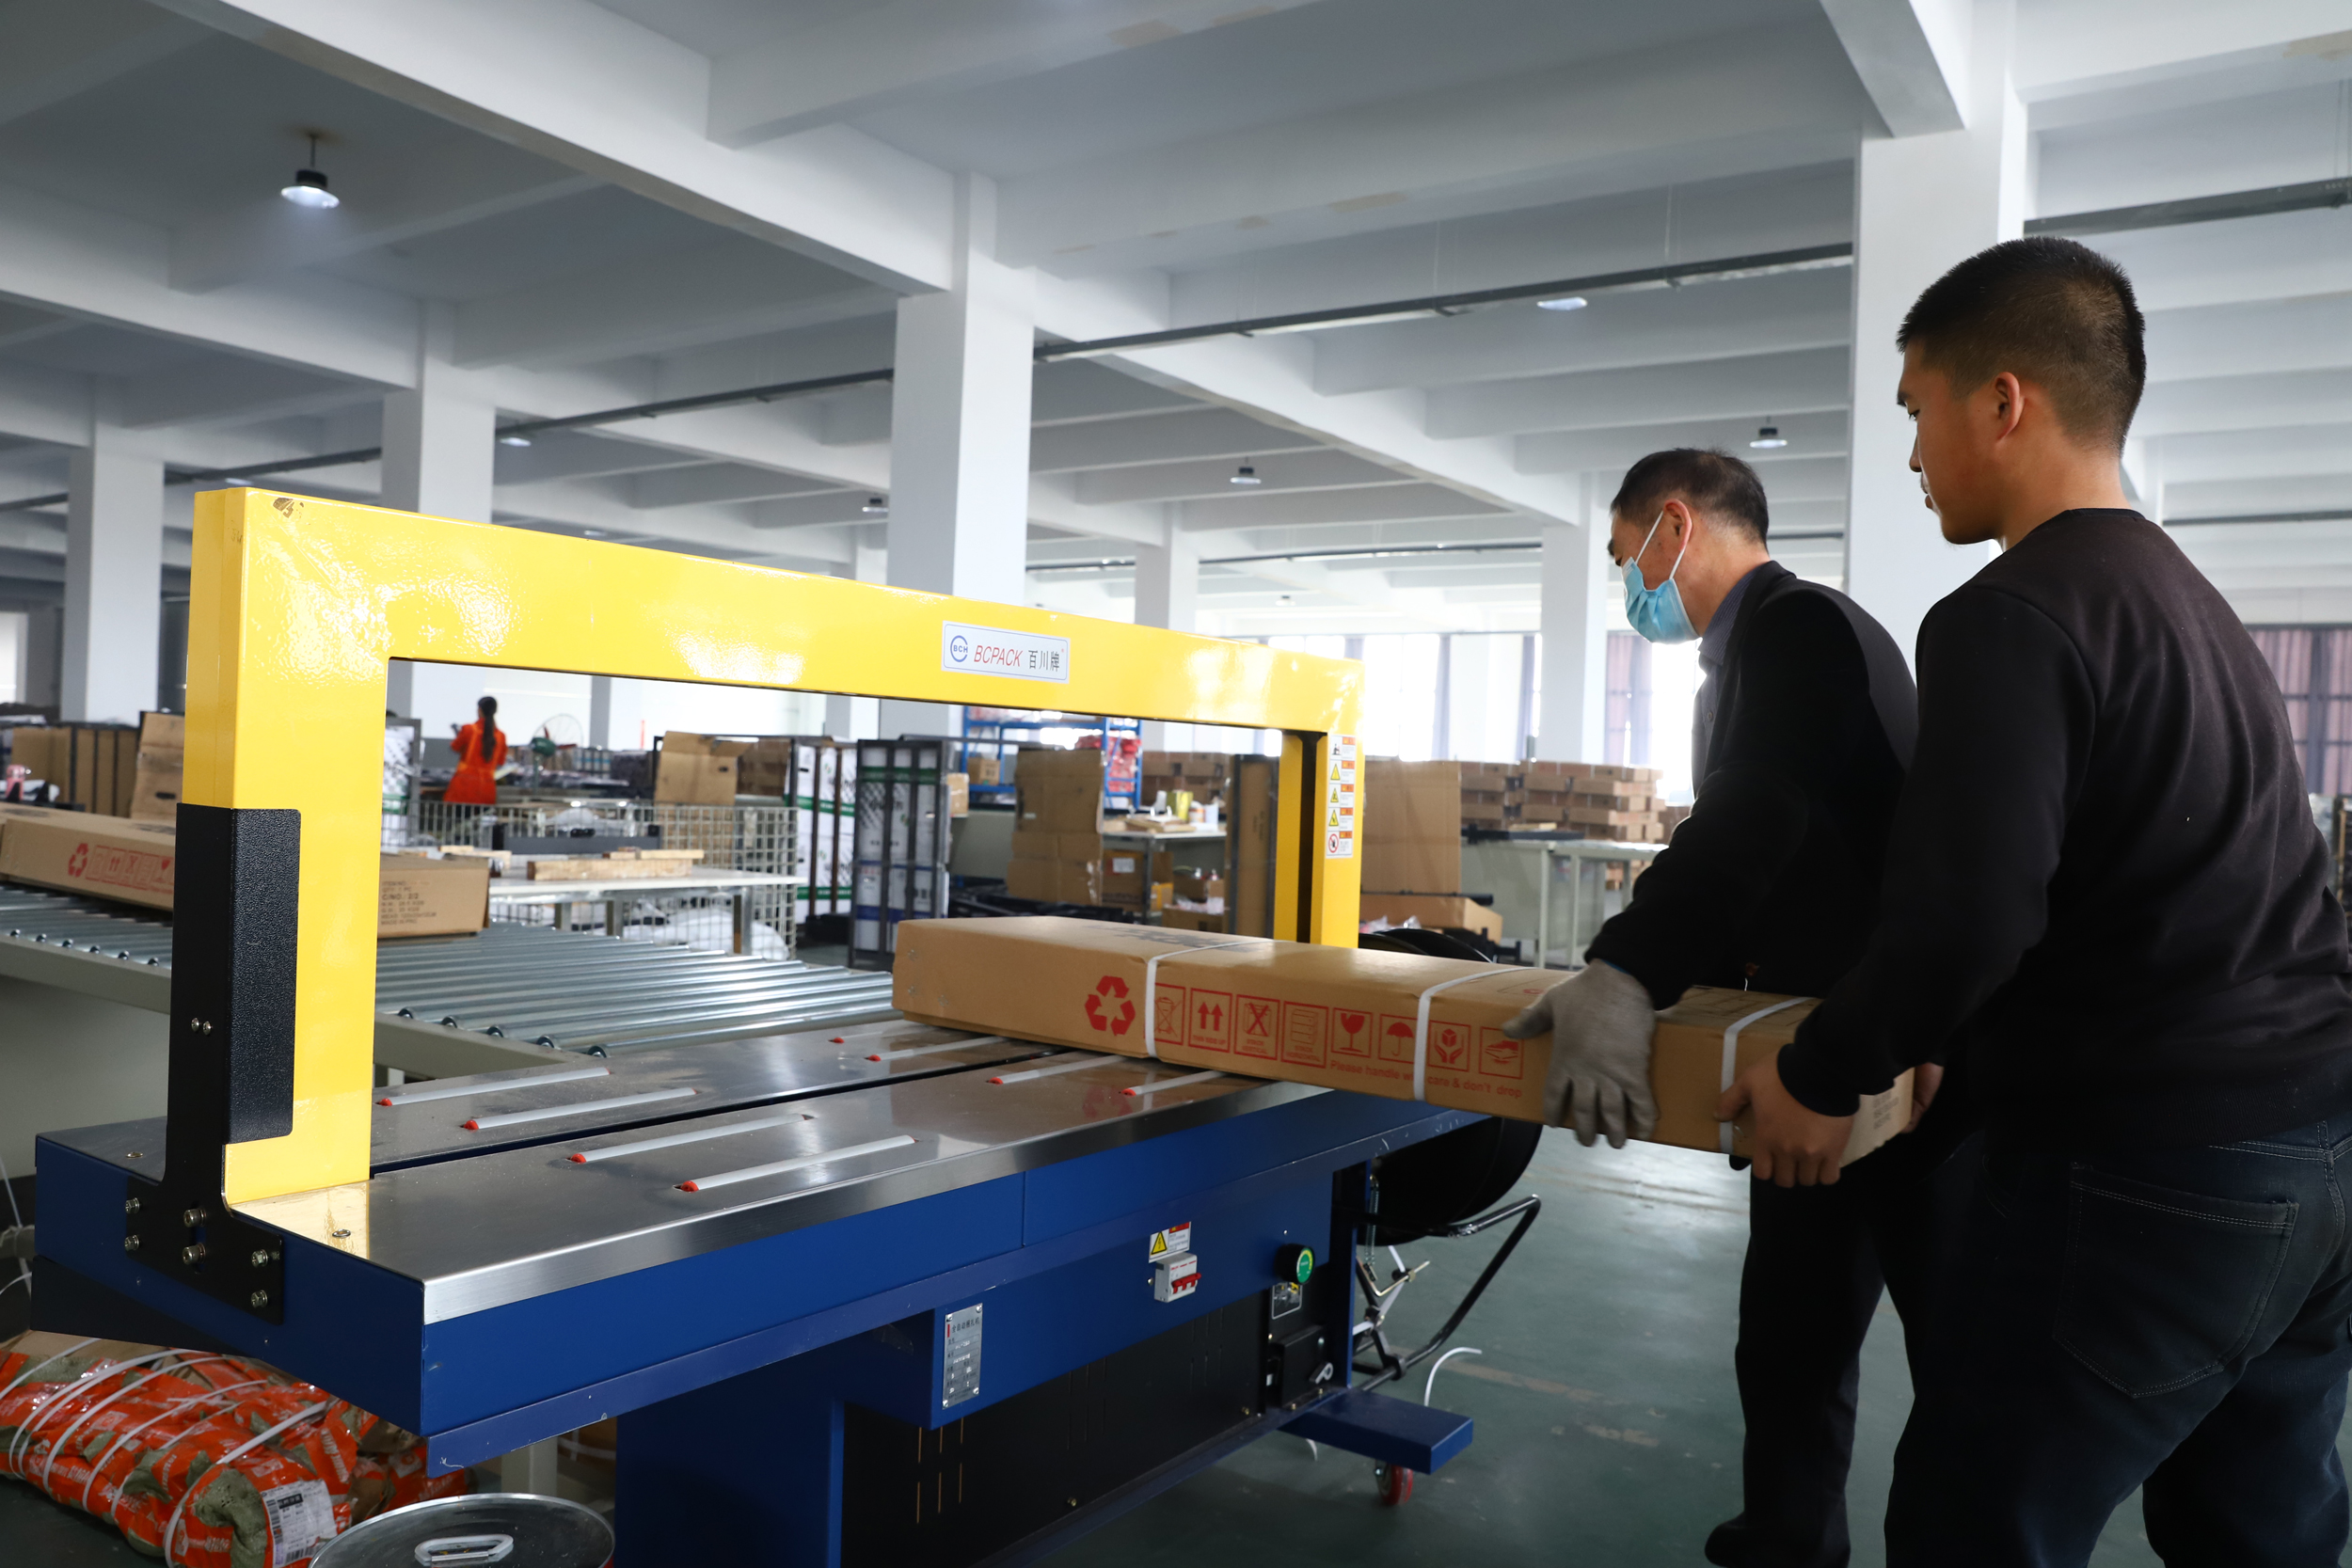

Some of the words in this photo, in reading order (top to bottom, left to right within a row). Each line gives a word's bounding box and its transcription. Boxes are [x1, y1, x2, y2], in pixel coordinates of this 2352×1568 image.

[953, 644, 968, 654] BCH
[974, 644, 1024, 668] BCPACK
[1028, 649, 1060, 673] 百川牌
[1330, 1060, 1362, 1074] Please
[1365, 1066, 1400, 1080] handle
[1427, 1075, 1450, 1086] care
[1453, 1077, 1460, 1088] &
[1464, 1081, 1491, 1093] don't
[1497, 1086, 1522, 1100] drop
